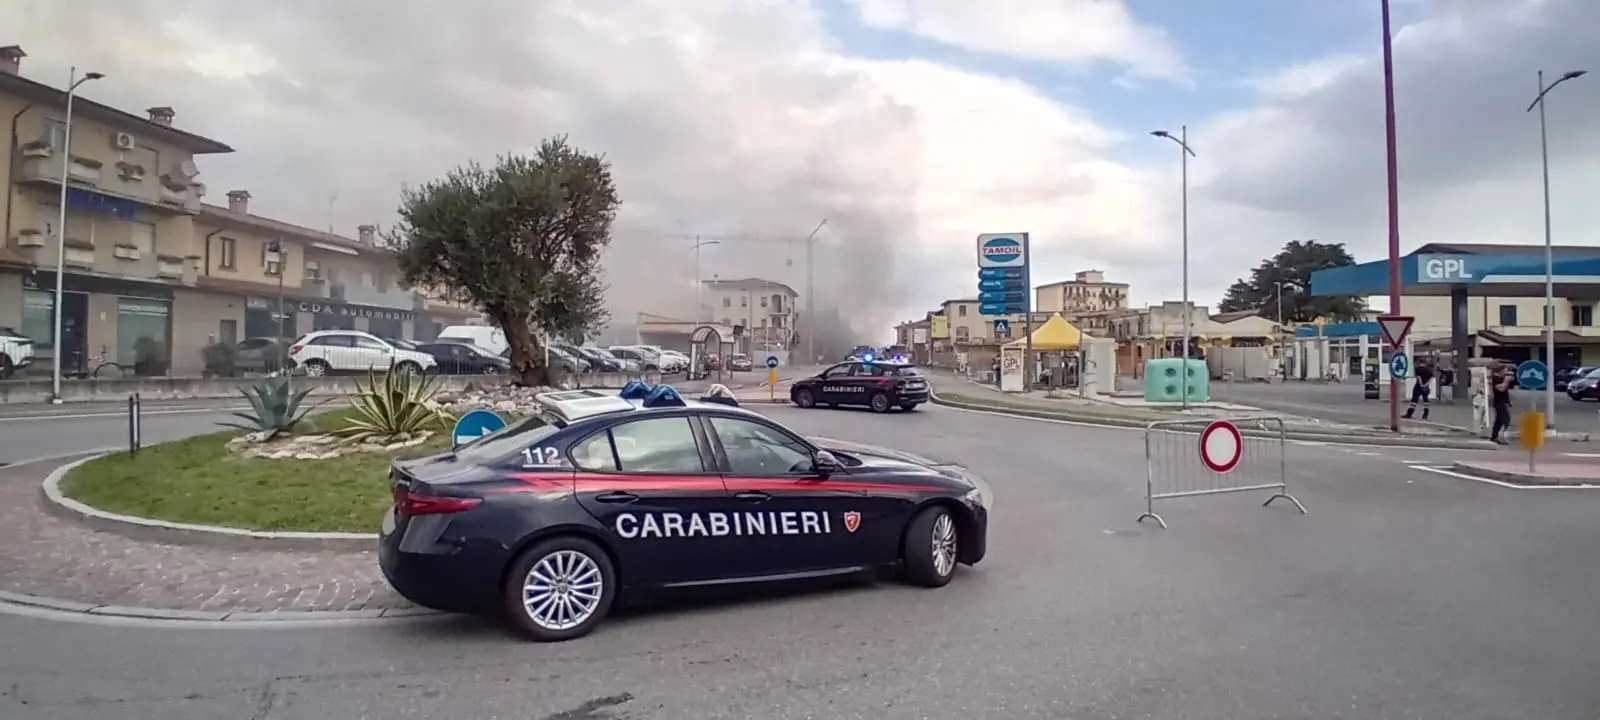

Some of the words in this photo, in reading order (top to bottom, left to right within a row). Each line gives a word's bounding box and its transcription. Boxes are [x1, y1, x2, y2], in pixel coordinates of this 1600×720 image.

[982, 246, 1022, 255] TAMOIL
[1426, 259, 1473, 279] GPL
[299, 302, 332, 314] CDA
[1004, 358, 1021, 368] GPL
[822, 385, 865, 393] CARABINIERI
[521, 446, 561, 464] 112
[615, 511, 831, 538] CARABINIERI
